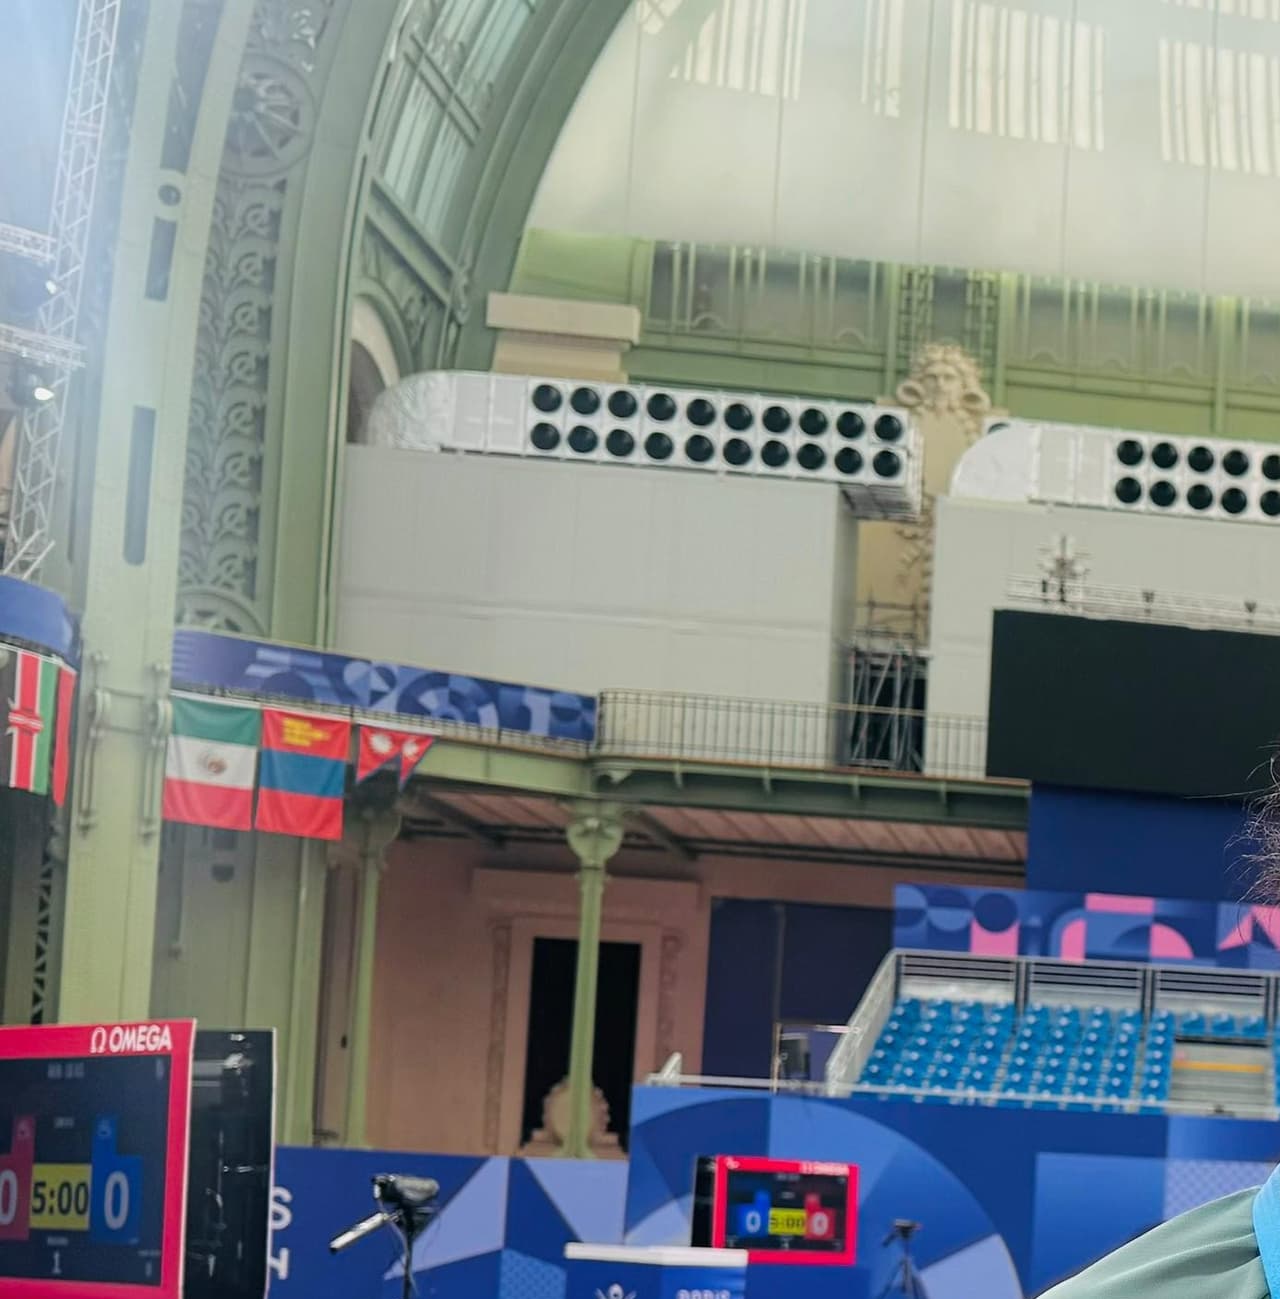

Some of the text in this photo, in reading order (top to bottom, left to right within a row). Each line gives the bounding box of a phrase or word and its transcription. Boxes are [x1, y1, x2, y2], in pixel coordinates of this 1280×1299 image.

[108, 1025, 173, 1053] OMEGA
[31, 1181, 90, 1215] 5:00
[103, 1170, 130, 1230] 0
